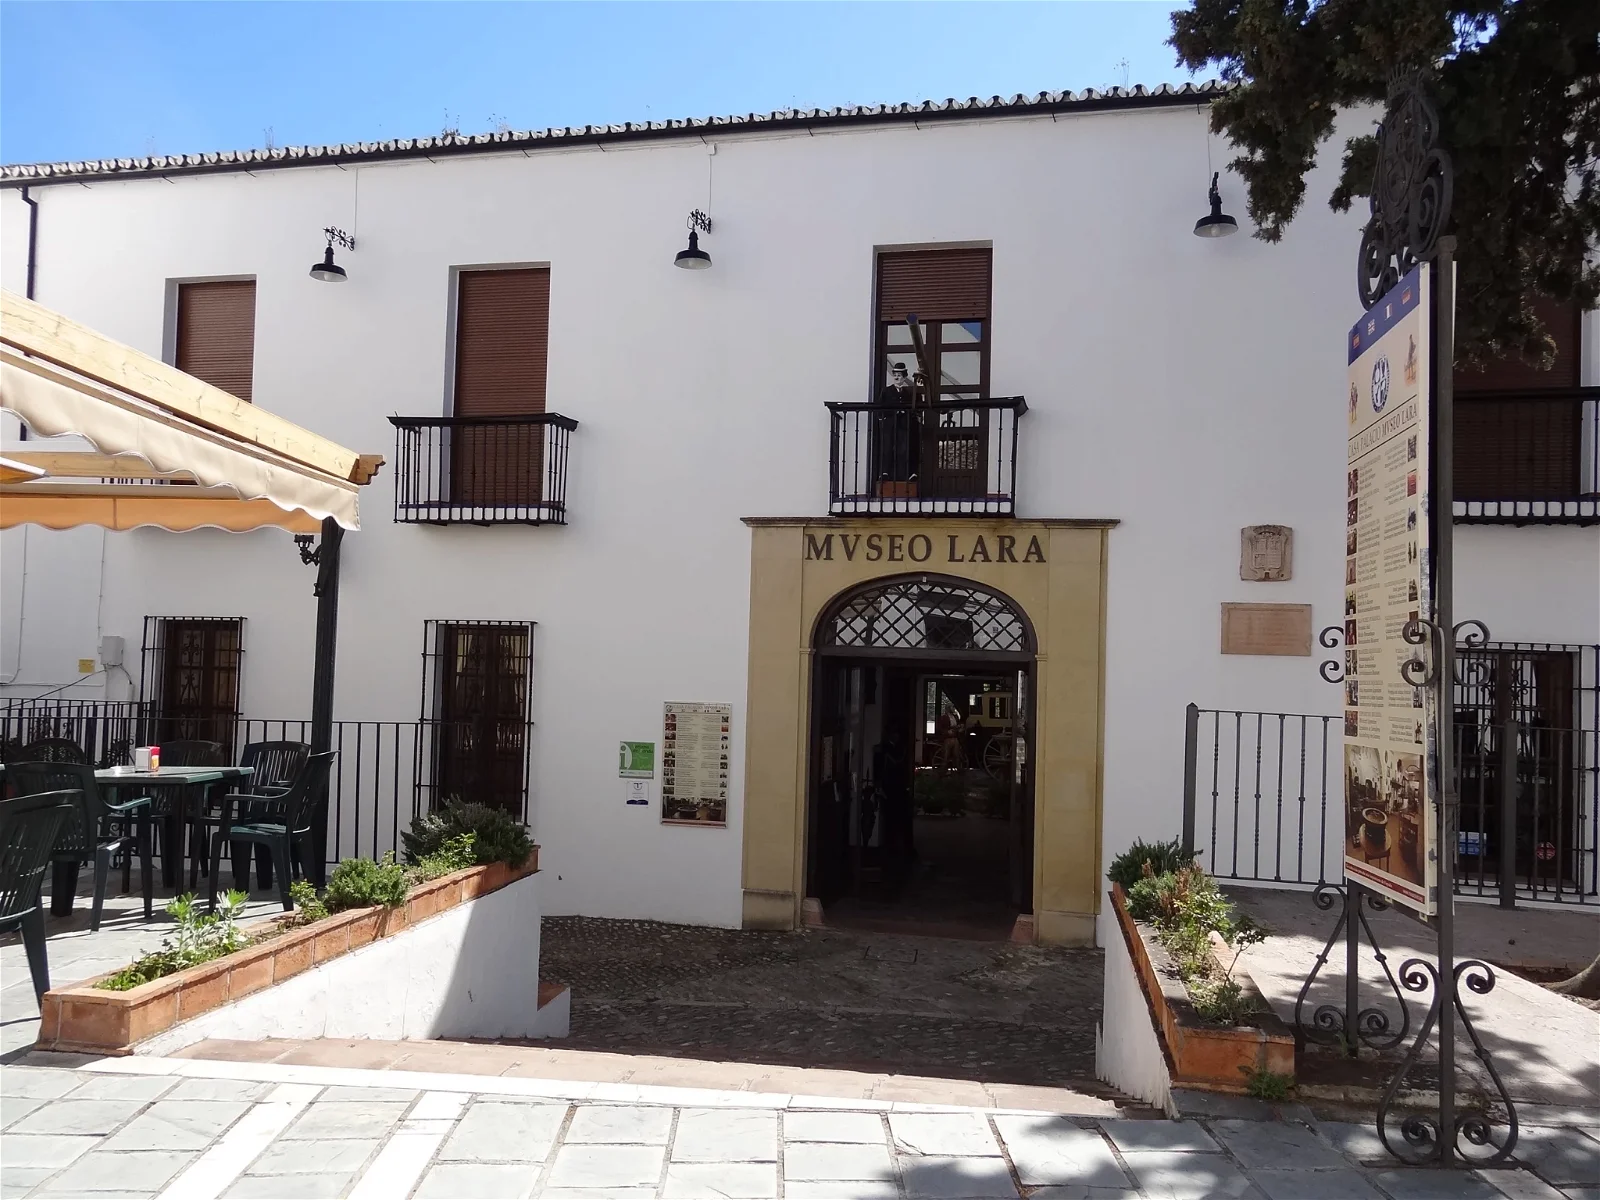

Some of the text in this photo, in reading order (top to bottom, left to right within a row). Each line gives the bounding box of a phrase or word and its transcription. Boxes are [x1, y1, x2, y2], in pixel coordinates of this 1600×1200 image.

[1360, 426, 1381, 452] PALACIO
[1401, 403, 1418, 425] LARA
[804, 533, 1047, 563] MVSEO LARA
